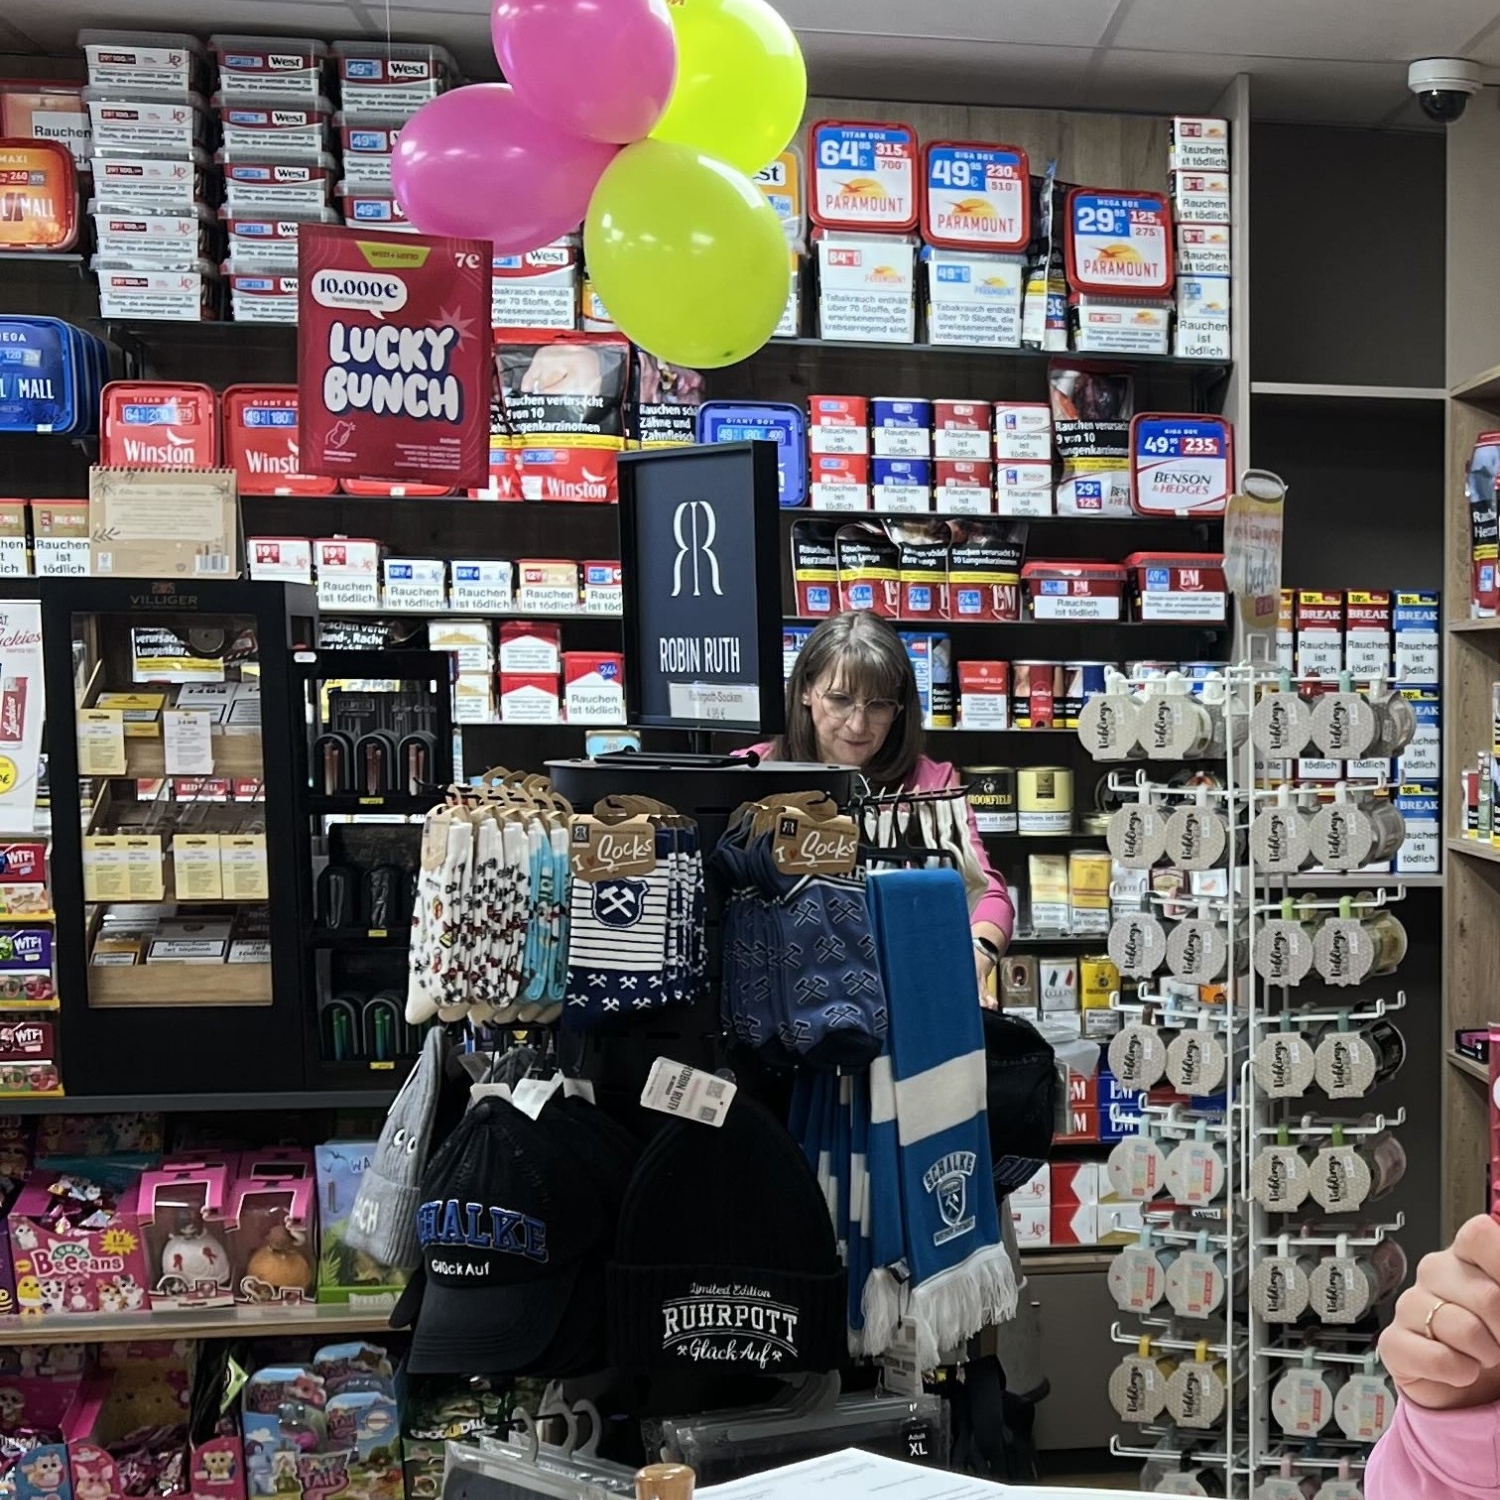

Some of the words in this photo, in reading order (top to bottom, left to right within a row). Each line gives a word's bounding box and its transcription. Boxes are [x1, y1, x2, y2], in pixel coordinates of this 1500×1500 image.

[271, 57, 300, 67] West
[391, 64, 425, 74] West
[275, 114, 303, 123] West
[35, 126, 91, 138] Rauchen
[821, 141, 859, 166] 64
[277, 170, 305, 179] West
[932, 160, 969, 186] 49
[20, 198, 55, 218] MALL
[826, 195, 904, 213] PARAMOUNT
[1183, 199, 1226, 208] Rauchen
[1195, 209, 1229, 219] tödlich
[938, 214, 1014, 233] PARAMOUNT
[1078, 208, 1114, 233] 29
[530, 250, 565, 264] West
[1183, 251, 1226, 261] Rauchen
[1084, 260, 1158, 278] PARAMOUNT
[1195, 262, 1229, 272] tödlich
[320, 278, 398, 299] 10.000€
[1180, 320, 1228, 332] Rauchen
[1197, 333, 1210, 344] ist
[330, 322, 455, 372] LUCKY
[1185, 344, 1223, 355] tödlich
[19, 379, 54, 398] MALL
[324, 366, 459, 421] BUNCH
[673, 419, 691, 428] und
[124, 437, 195, 464] Winston
[1145, 437, 1169, 454] 49
[1154, 472, 1211, 485] BENSON
[547, 477, 606, 498] Winston
[1159, 483, 1210, 494] HEDGES
[36, 540, 90, 550] Rauchen
[56, 553, 71, 562] ist
[43, 564, 85, 574] tödlich
[323, 581, 372, 591] Rauchen
[391, 587, 439, 597] Rauchen
[458, 589, 506, 598] Rauchen
[526, 590, 573, 599] Rauchen
[131, 596, 198, 604] VILLIGER
[321, 593, 335, 602] ist
[338, 592, 376, 603] tödlich
[388, 598, 402, 607] ist
[404, 597, 441, 608] tödlich
[456, 599, 470, 608] ist
[472, 598, 510, 608] tödlich
[523, 600, 537, 609] ist
[1069, 608, 1099, 617] tödlich
[1301, 610, 1341, 619] BREAK
[1348, 609, 1389, 619] BREAK
[1398, 611, 1438, 620] BREAK
[660, 637, 700, 673] ROBIN
[705, 637, 740, 673] RUTH
[1315, 653, 1326, 662] ist
[1362, 653, 1375, 661] ist
[1412, 654, 1424, 662] ist
[571, 695, 617, 704] Rauchen
[585, 705, 621, 715] tödlich
[1304, 761, 1337, 770] tödlich
[1404, 760, 1436, 769] tödlich
[1401, 800, 1438, 810] BREAK
[801, 831, 856, 866] Socks
[1413, 843, 1425, 851] ist
[597, 835, 652, 871] Socks
[1403, 854, 1435, 863] tödlich
[924, 1153, 974, 1188] SCHALKE
[466, 1262, 489, 1276] Auf
[690, 1282, 730, 1296] Limited
[733, 1284, 771, 1298] Edition
[662, 1304, 798, 1343] RUHRPOTT
[690, 1338, 738, 1360] Glück
[739, 1344, 771, 1369] Auf
[909, 1442, 928, 1456] XL
